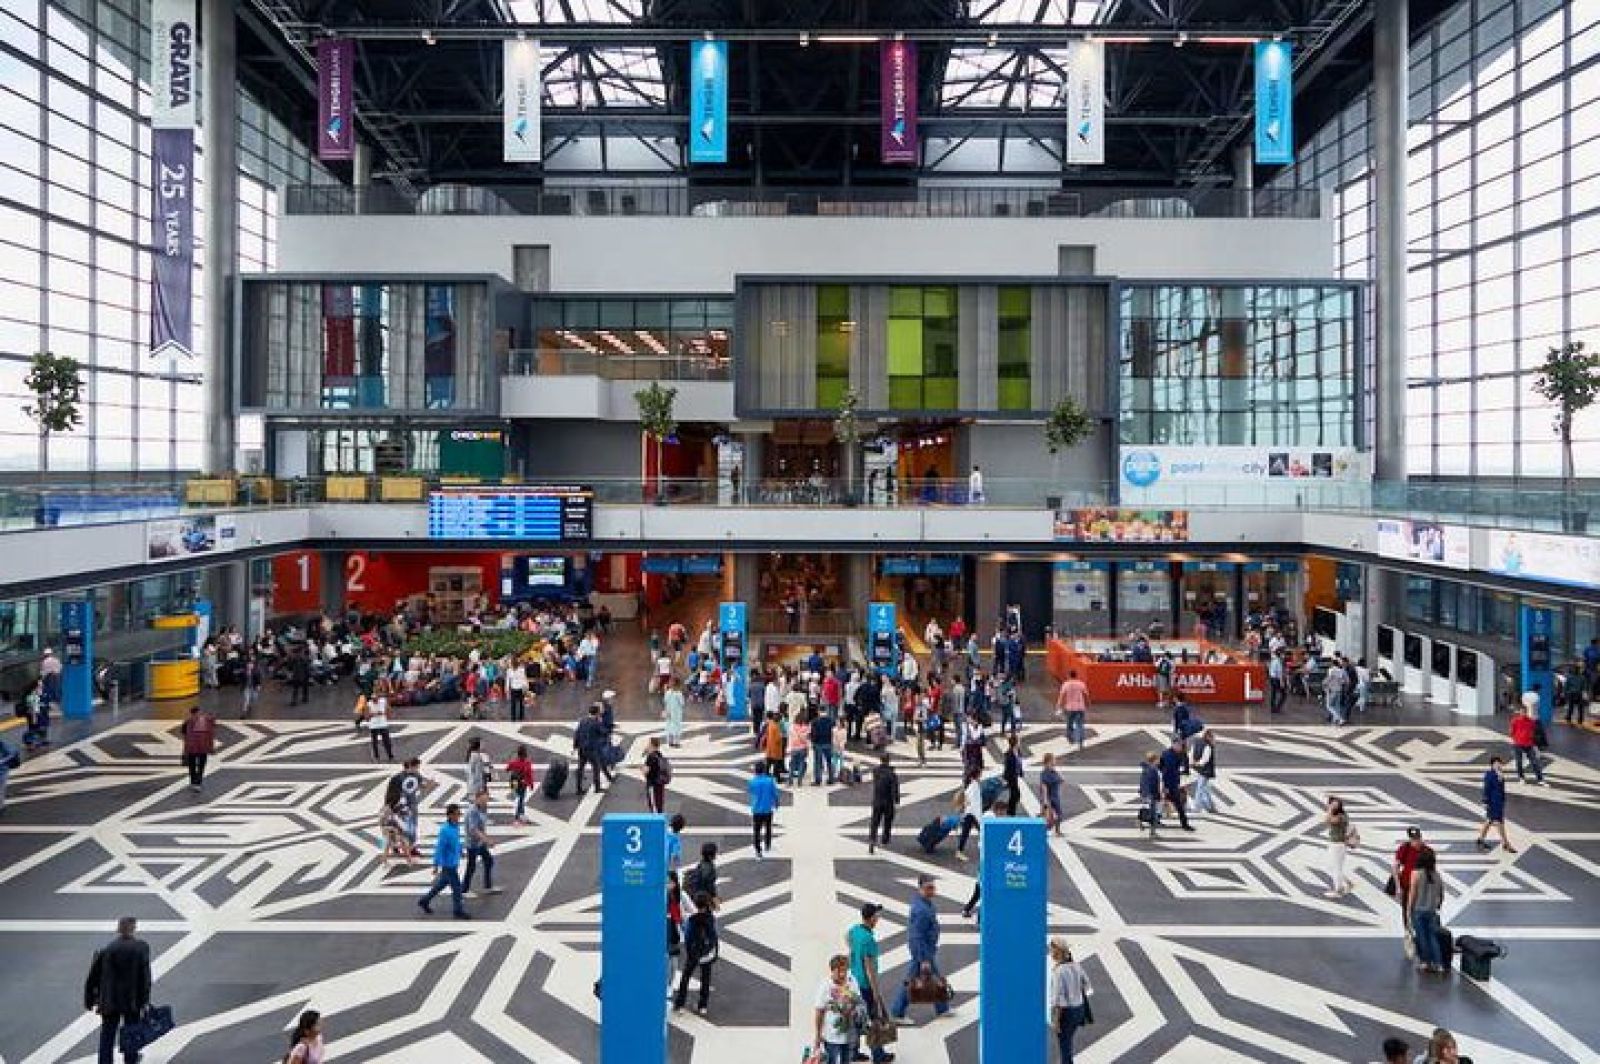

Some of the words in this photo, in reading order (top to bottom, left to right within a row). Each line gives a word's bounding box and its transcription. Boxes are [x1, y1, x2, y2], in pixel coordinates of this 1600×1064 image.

[170, 22, 191, 109] GRATA
[162, 164, 186, 199] 25
[166, 210, 181, 257] YEARS
[297, 555, 310, 591] 1
[347, 554, 365, 591] 2
[626, 825, 642, 854] 3
[1008, 829, 1024, 856] 4
